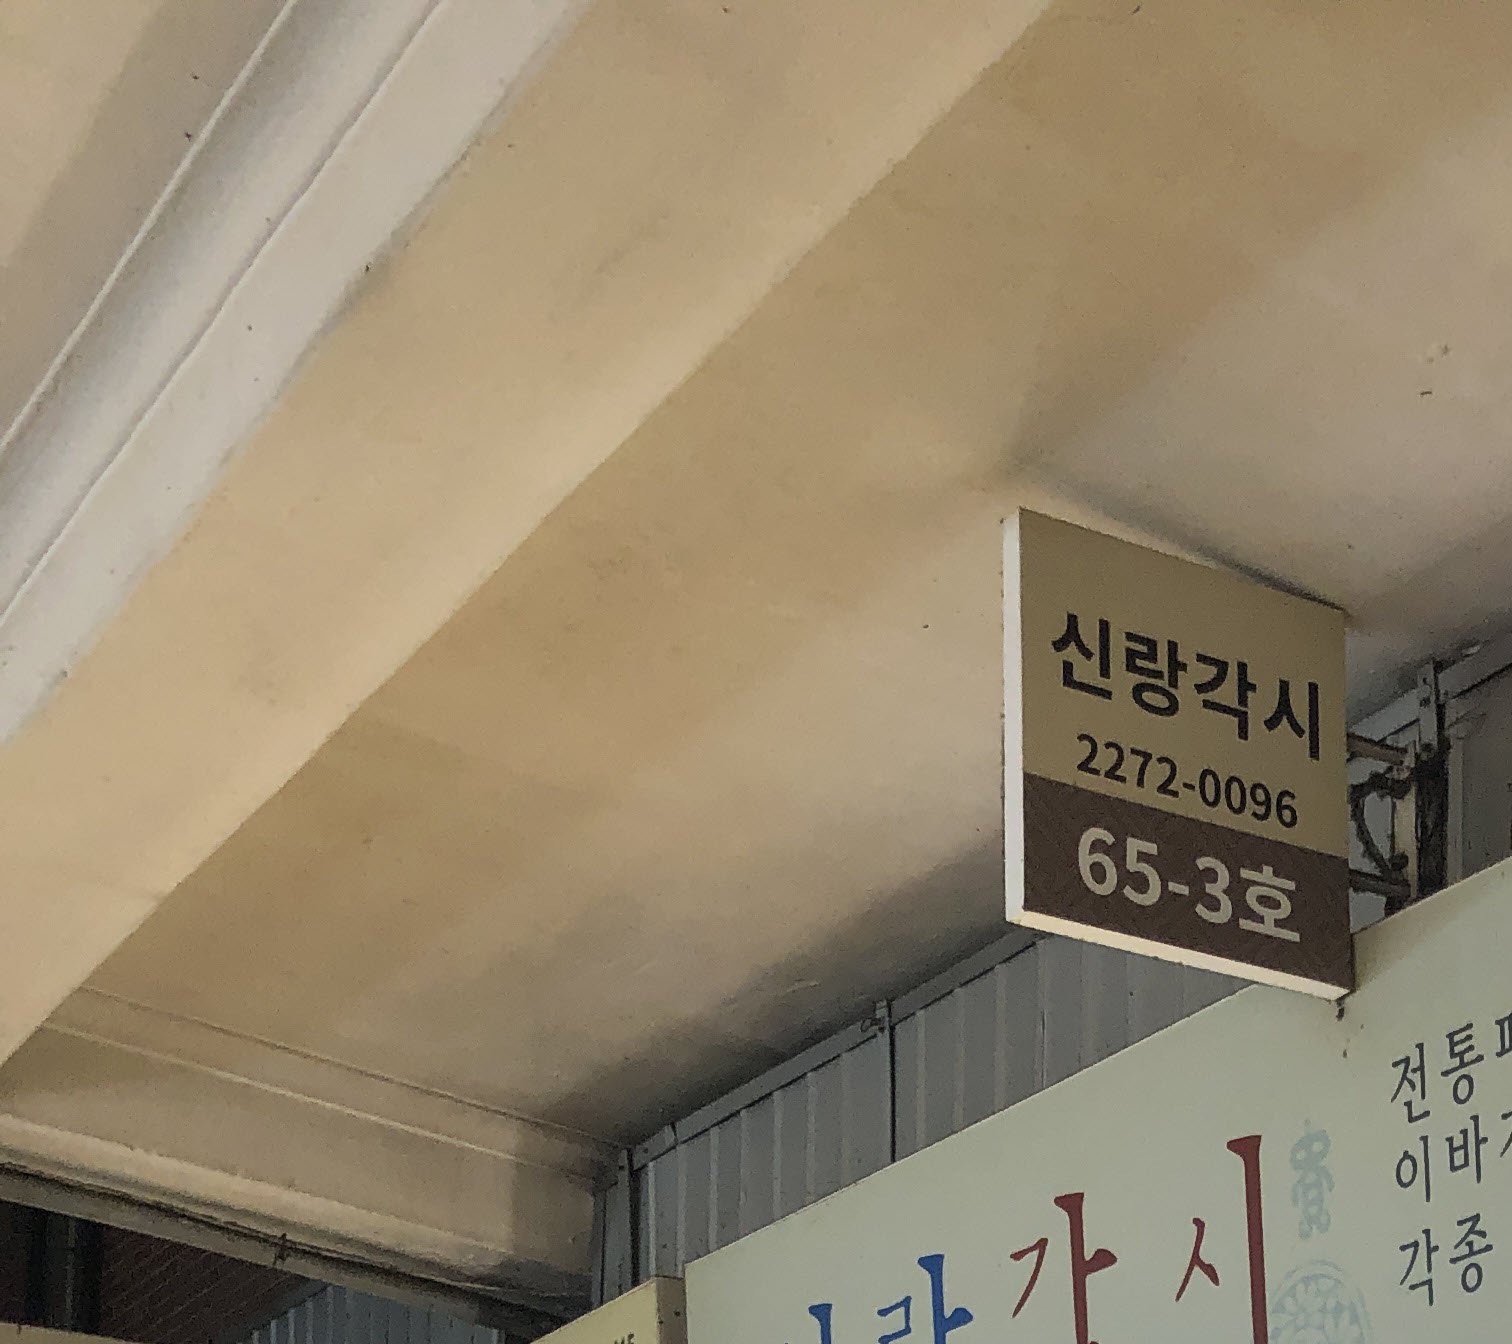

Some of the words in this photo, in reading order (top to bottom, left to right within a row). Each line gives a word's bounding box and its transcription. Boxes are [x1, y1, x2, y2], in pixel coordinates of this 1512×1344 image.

[1052, 611, 1320, 761] 신랑각시
[1076, 733, 1298, 829] 2272-0096
[1077, 826, 1300, 942] 65-3호
[1398, 1213, 1494, 1307] 각종
